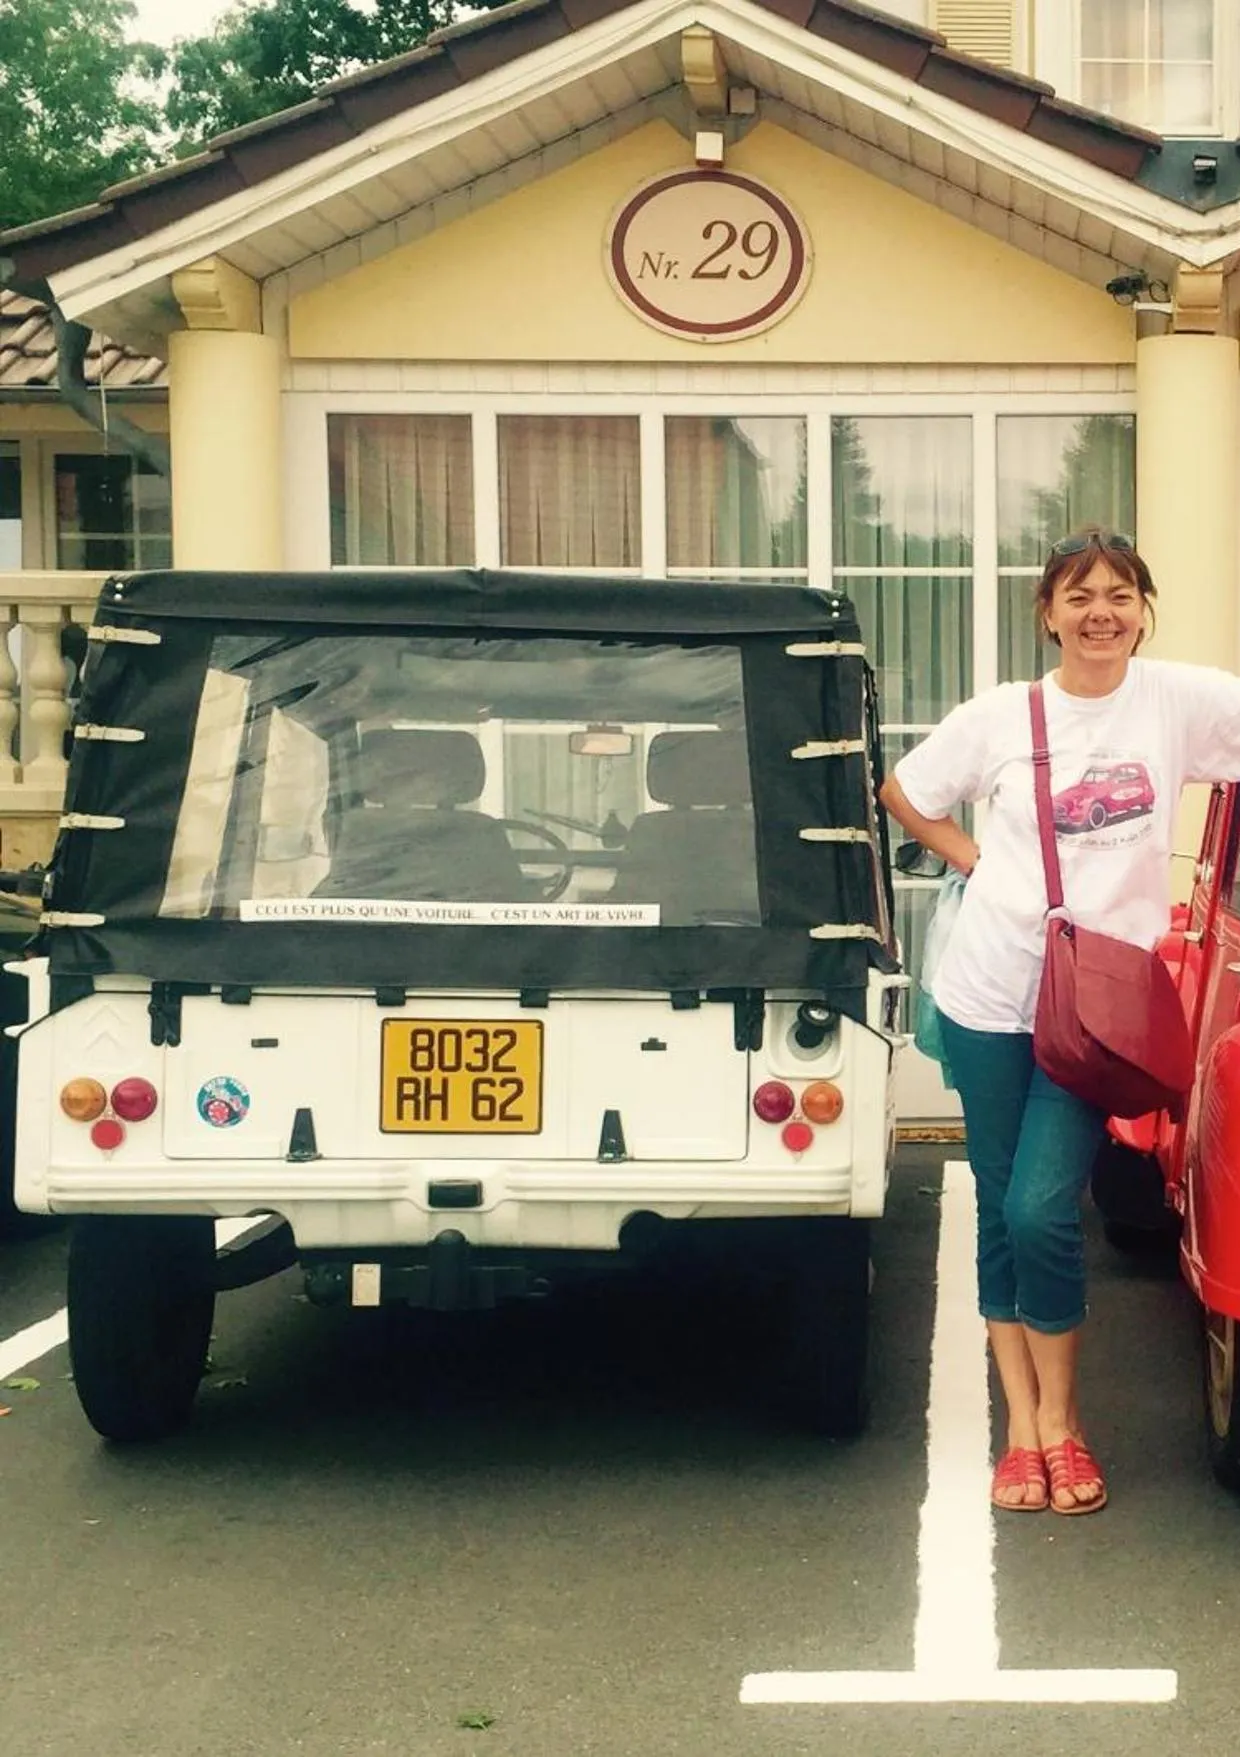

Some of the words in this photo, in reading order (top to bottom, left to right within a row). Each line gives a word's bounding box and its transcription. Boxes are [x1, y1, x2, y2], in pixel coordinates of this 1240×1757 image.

[637, 251, 679, 280] Nr.
[690, 220, 779, 281] 29
[255, 904, 288, 915] CECI
[292, 904, 317, 915] EST
[321, 904, 356, 916] PLUS
[490, 908, 528, 920] C'EST
[532, 909, 552, 920] UN
[556, 909, 580, 920] ART
[585, 909, 601, 920] DE
[410, 1028, 517, 1073] 8032
[396, 1077, 449, 1121] RH
[471, 1077, 524, 1122] 62
